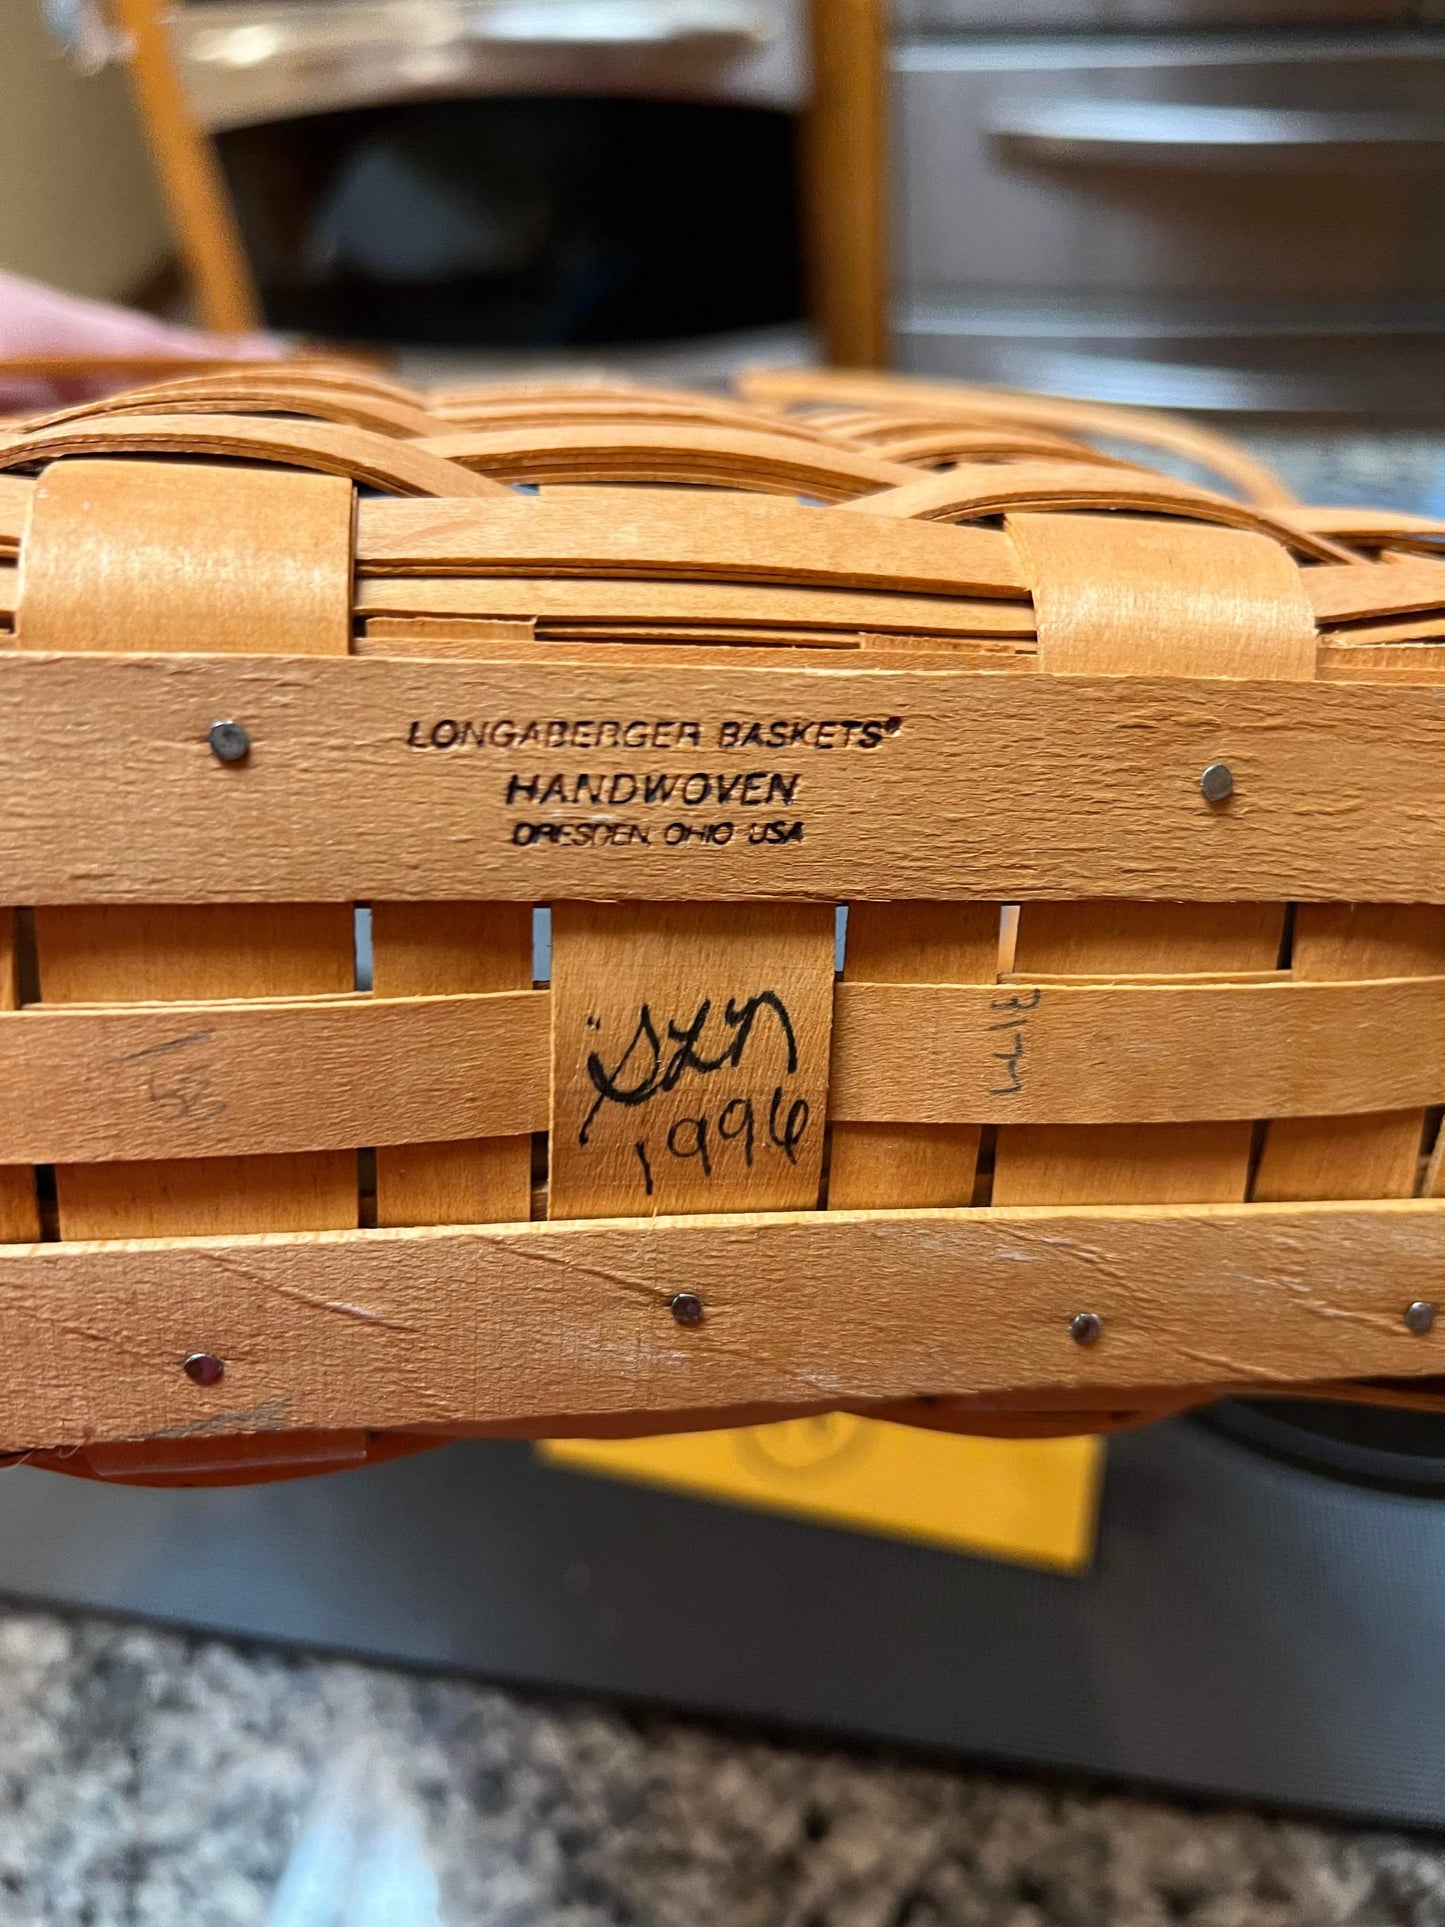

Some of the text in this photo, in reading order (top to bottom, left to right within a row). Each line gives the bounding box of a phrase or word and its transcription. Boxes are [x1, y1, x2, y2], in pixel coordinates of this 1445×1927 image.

[405, 718, 700, 750] LONGABERGER
[506, 771, 801, 806] HANDWOVEN
[664, 821, 734, 846] OHIO
[748, 820, 804, 846] USA
[635, 1086, 809, 1196] 1996
